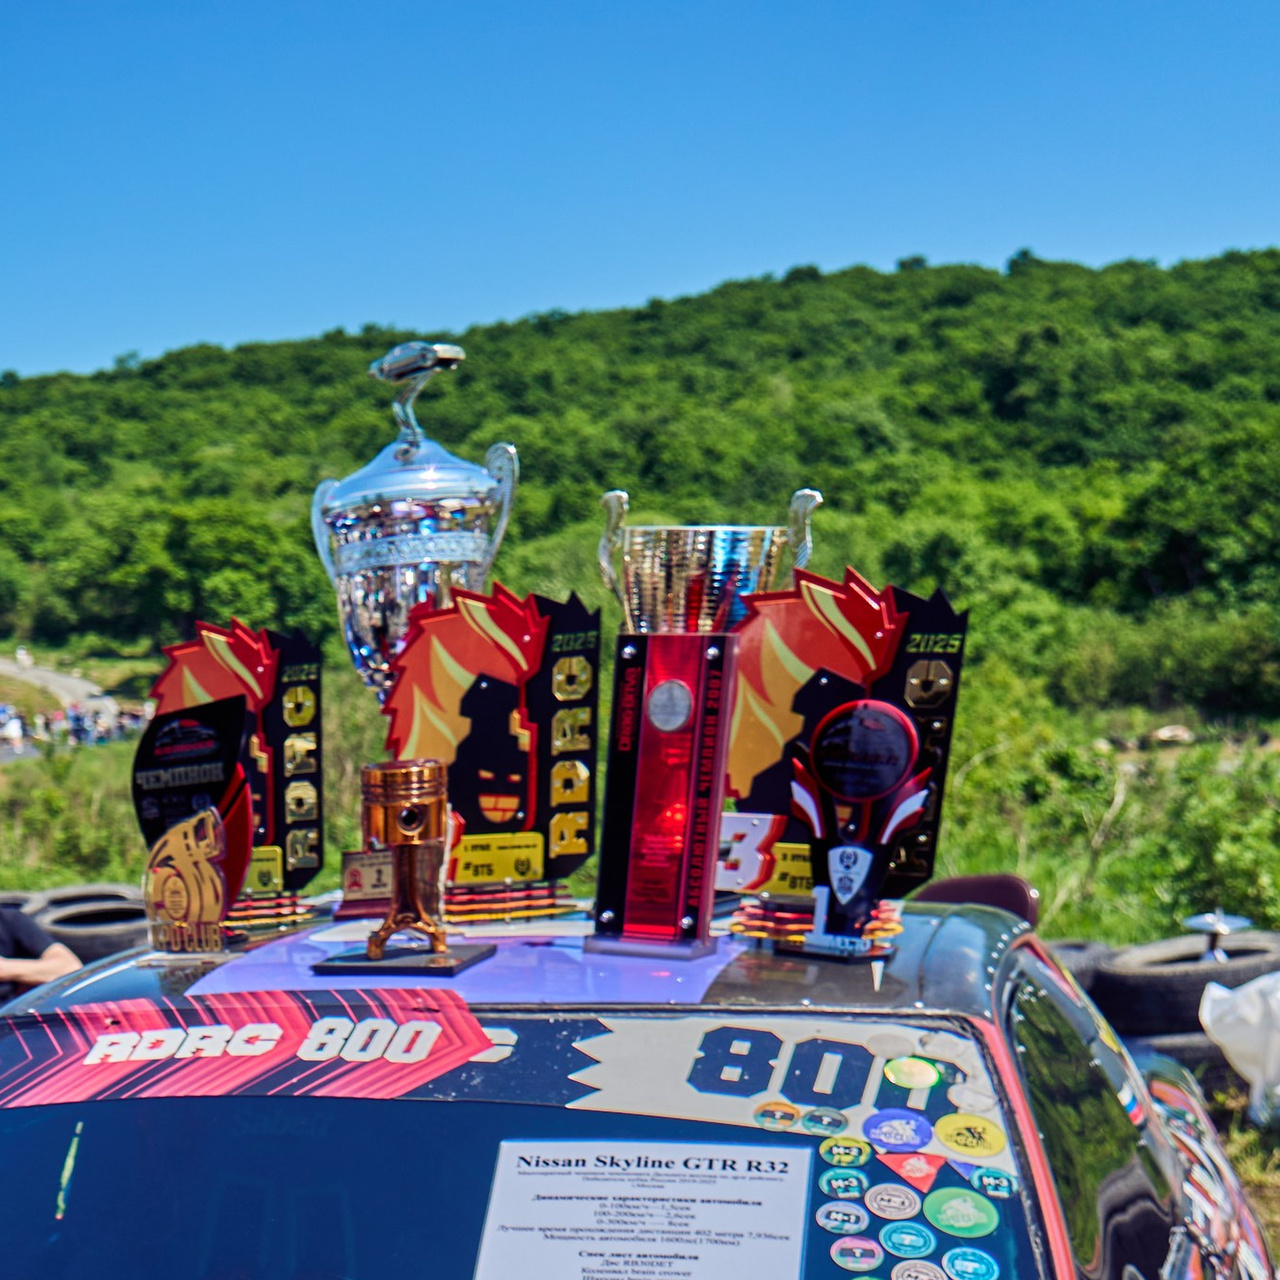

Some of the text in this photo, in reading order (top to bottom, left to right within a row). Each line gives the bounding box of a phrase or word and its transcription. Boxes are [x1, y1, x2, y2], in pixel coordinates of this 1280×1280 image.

[552, 631, 598, 651] 2025
[906, 634, 963, 654] 2025
[135, 763, 225, 790] ЧЕМПИОН
[296, 1016, 443, 1063] 800
[517, 1155, 788, 1173] Nissan Skyline GTR R32
